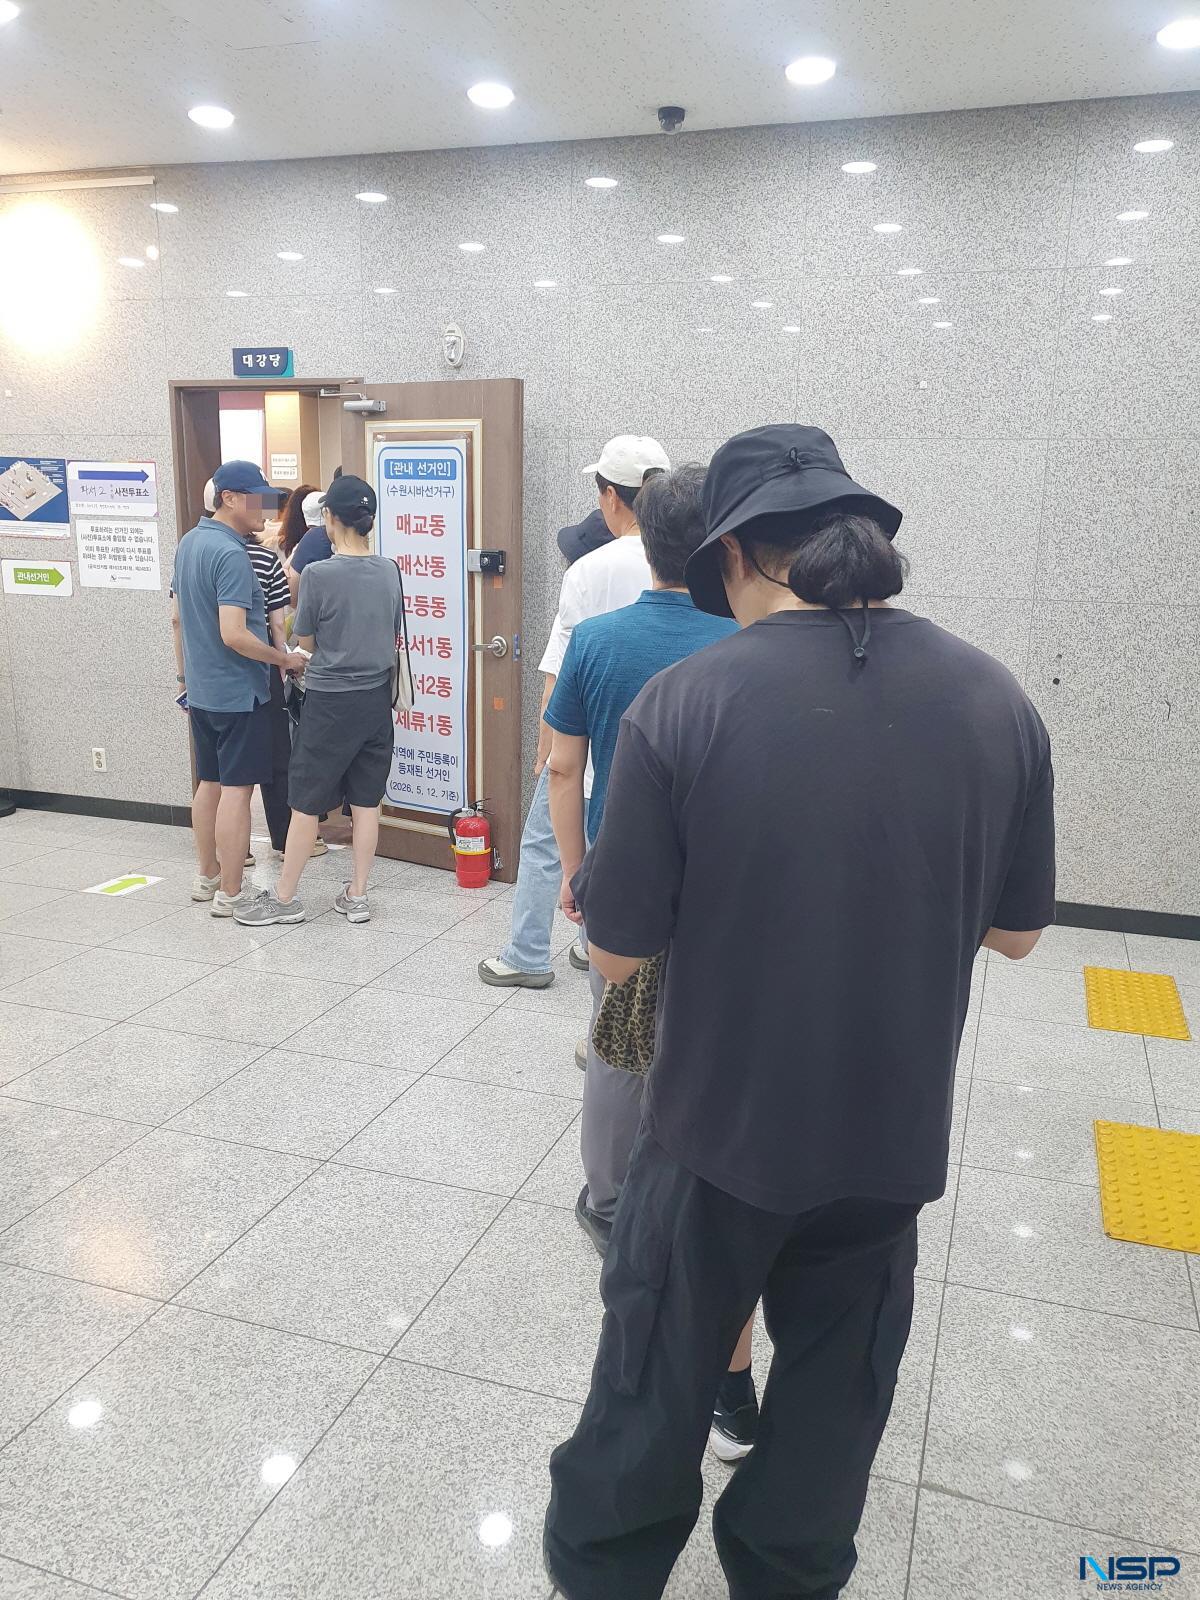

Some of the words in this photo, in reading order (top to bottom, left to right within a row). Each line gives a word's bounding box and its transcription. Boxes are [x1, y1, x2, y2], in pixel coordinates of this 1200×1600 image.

[242, 353, 280, 368] 대강당
[390, 461, 413, 476] [관내
[417, 462, 451, 477] 선거인]
[115, 487, 150, 497] 사전투표소
[387, 484, 455, 498] (수원시바선거구)
[396, 513, 446, 538] 매교동
[397, 554, 447, 579] 매산동
[17, 571, 50, 583] 관내선거인
[413, 673, 453, 699] 서2동
[395, 710, 453, 737] 세류1동
[417, 749, 458, 768] 주민등록이
[398, 762, 423, 777] 등재된
[425, 767, 450, 782] 선거인
[390, 780, 414, 794] (2026.
[416, 785, 424, 796] 5.
[427, 787, 438, 798] 12.
[441, 790, 459, 802] 기준)
